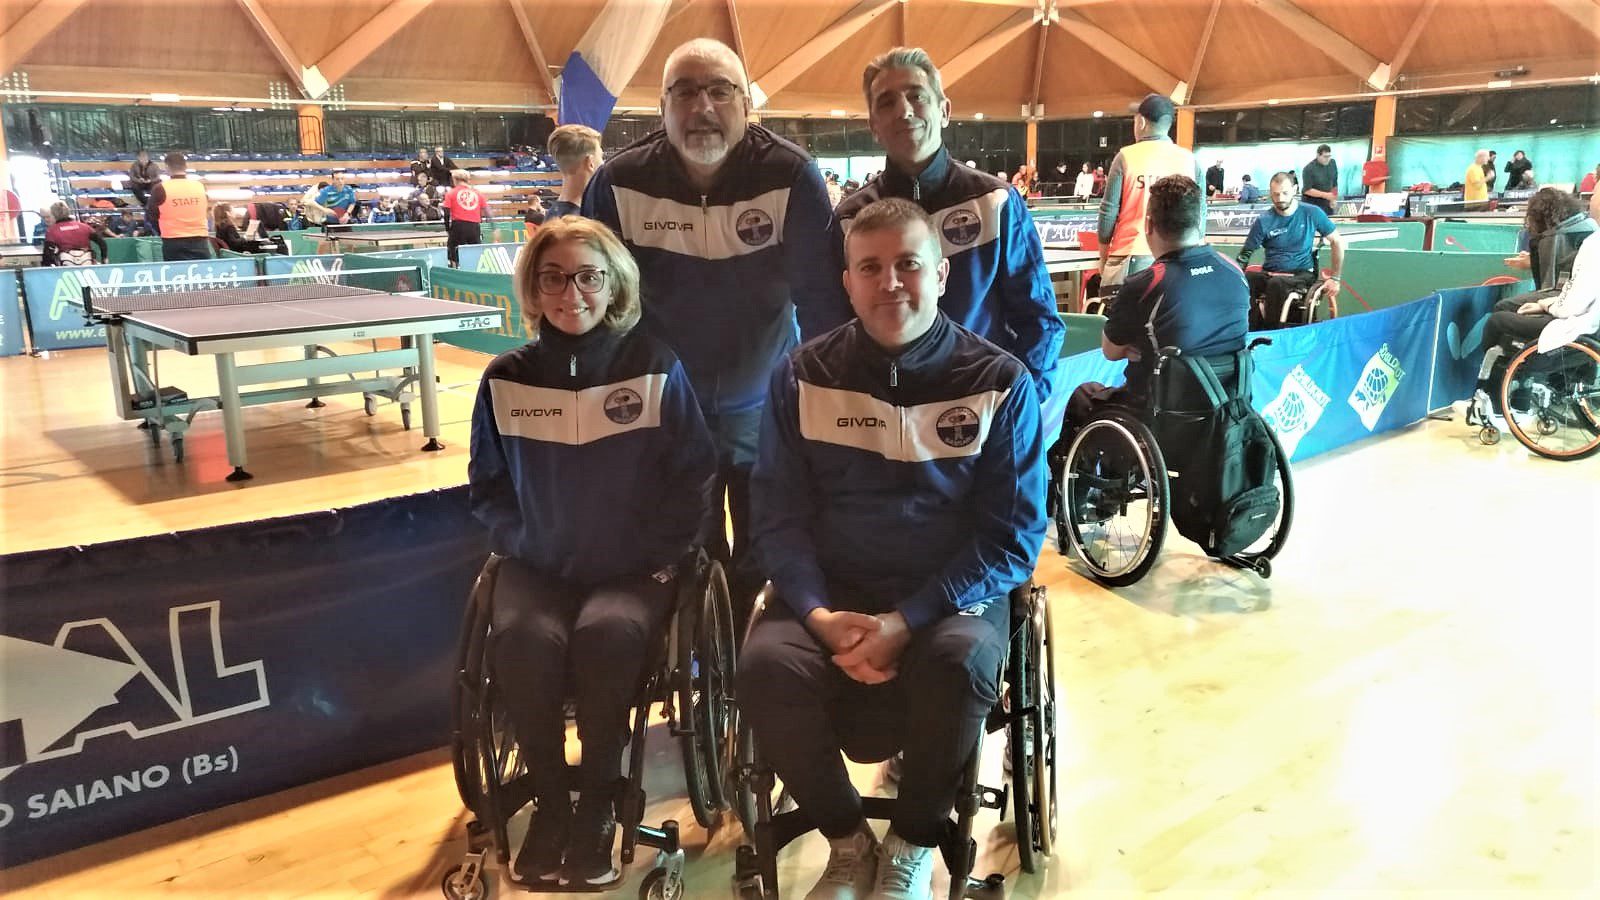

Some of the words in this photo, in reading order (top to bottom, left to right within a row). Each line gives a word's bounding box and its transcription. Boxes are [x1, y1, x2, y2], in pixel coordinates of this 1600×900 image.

[172, 197, 202, 207] STAFF
[643, 221, 694, 232] GIVOVA
[458, 317, 491, 328] STAG
[510, 408, 563, 417] GIVOVA
[27, 765, 170, 819] SAIANO
[182, 745, 239, 785] (Bs)
